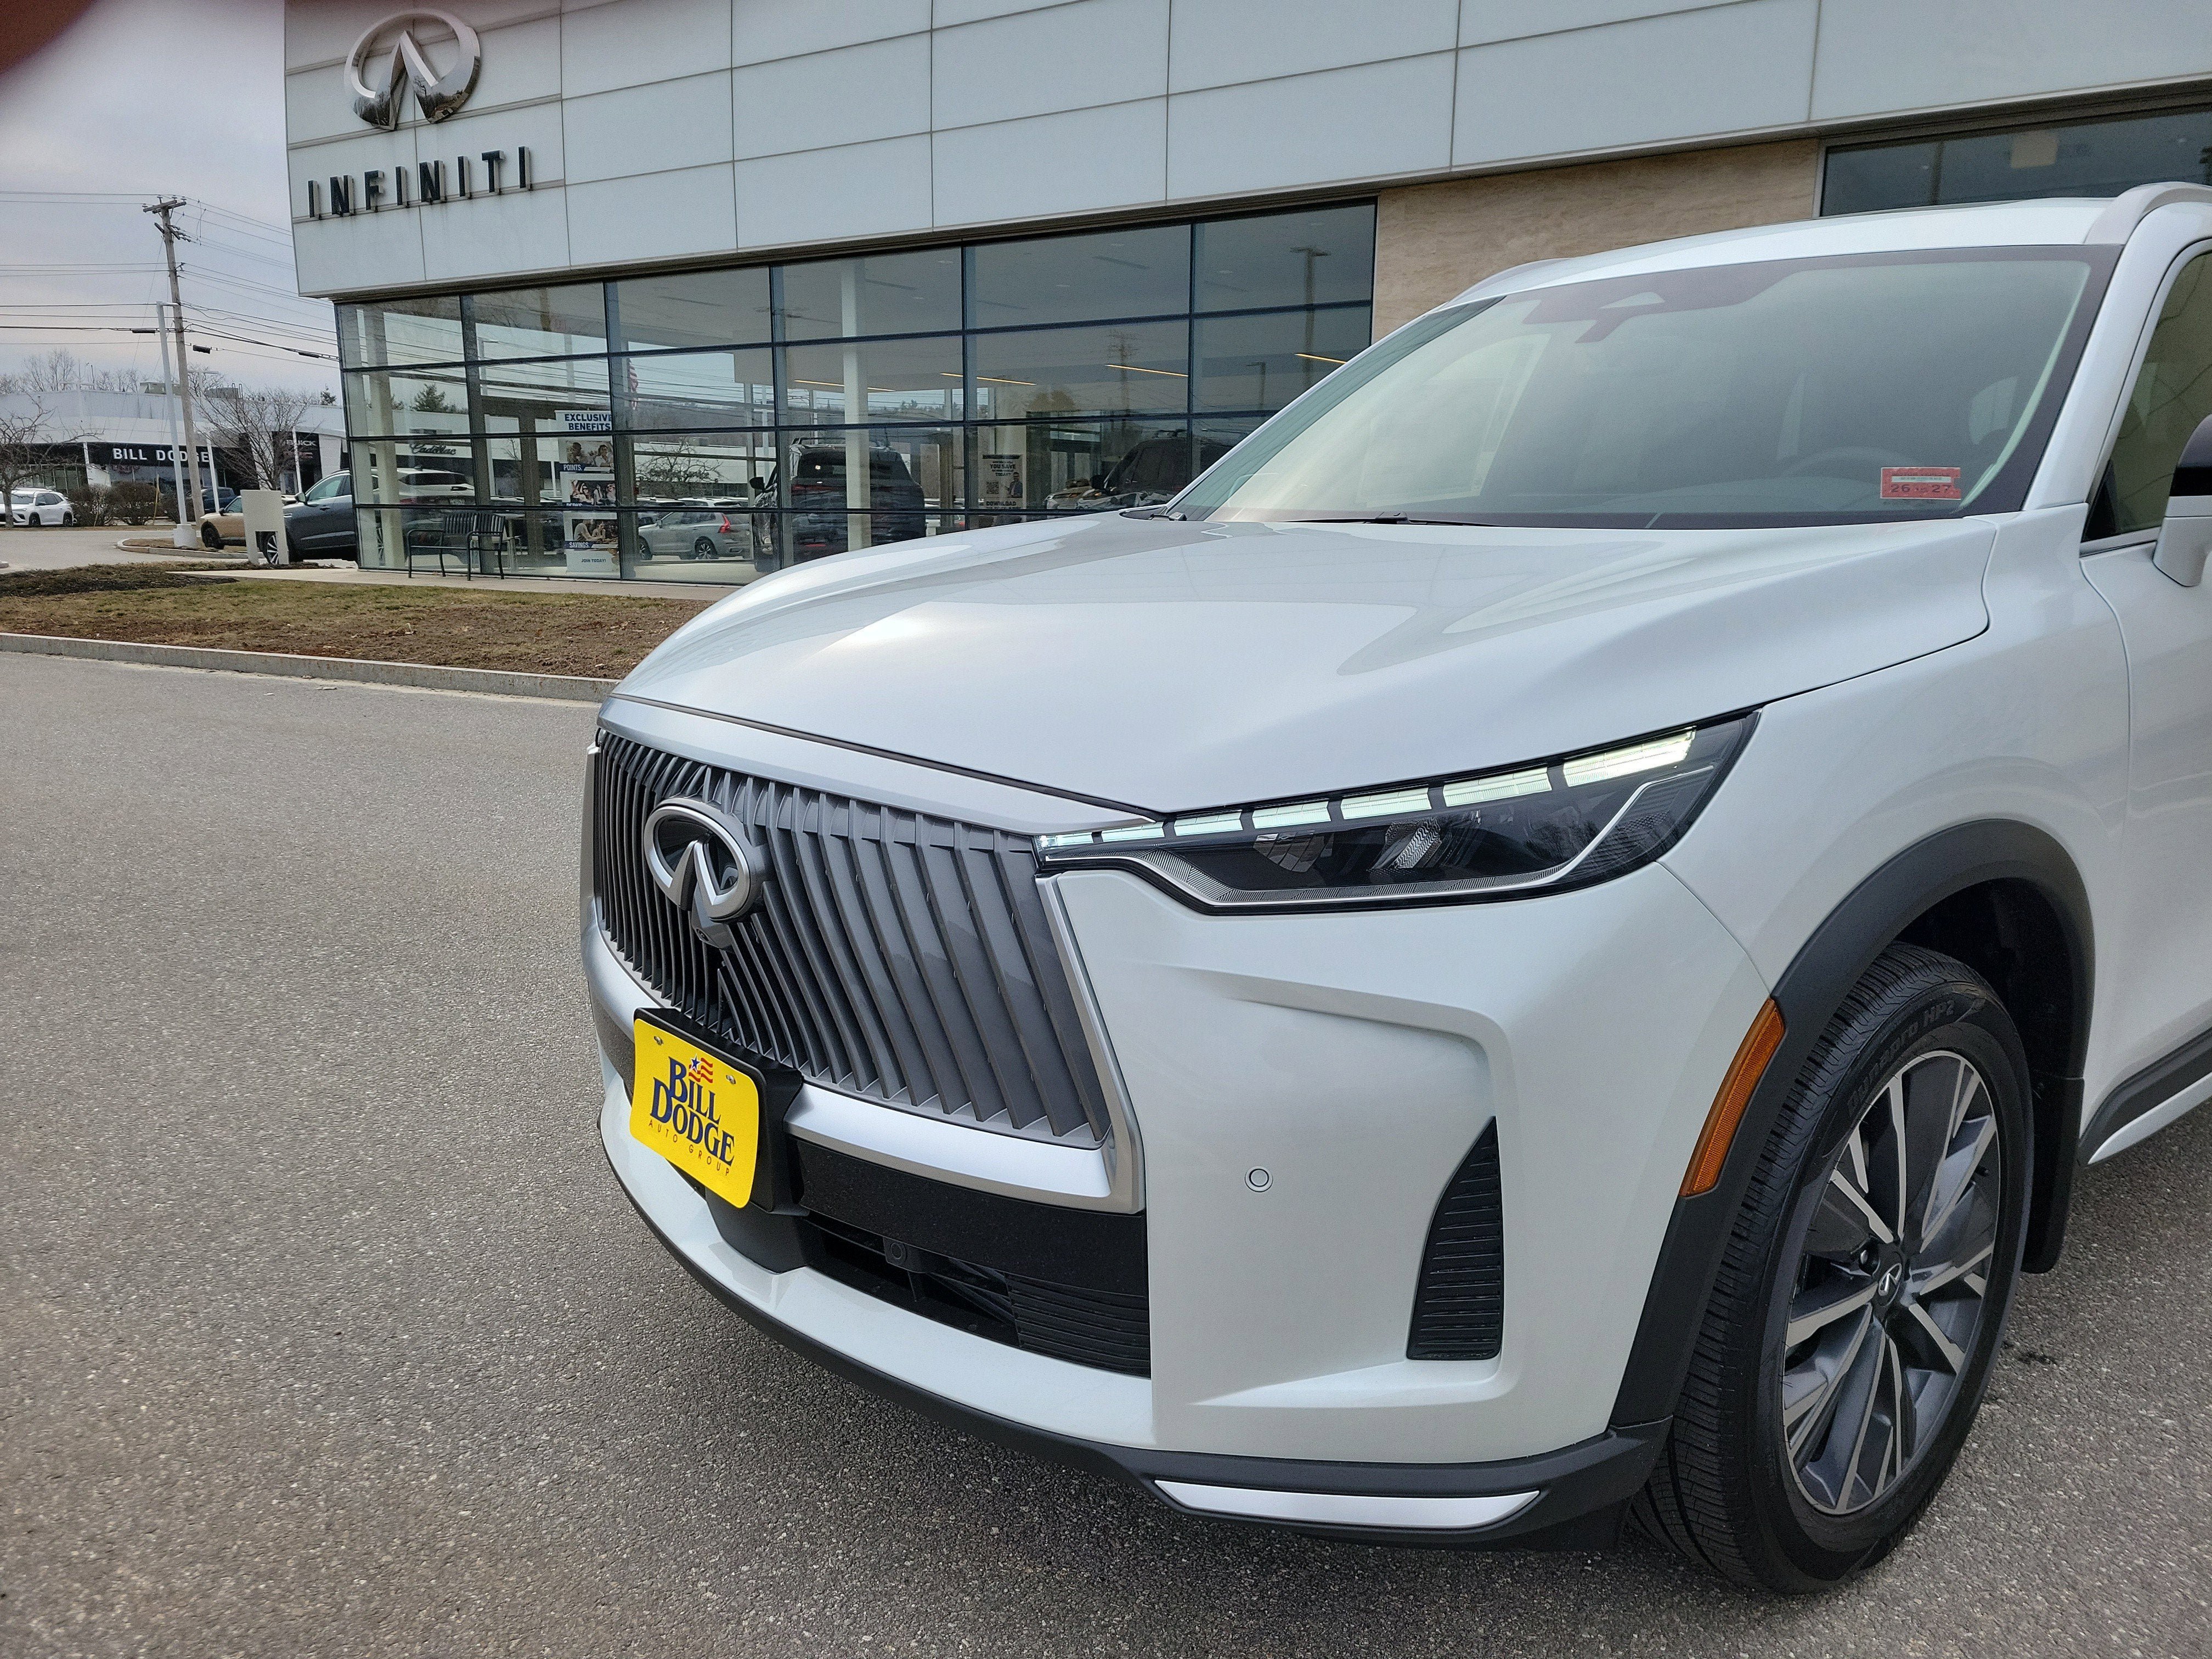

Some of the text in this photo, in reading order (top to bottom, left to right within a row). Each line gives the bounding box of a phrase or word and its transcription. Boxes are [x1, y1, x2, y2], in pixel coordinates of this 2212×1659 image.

[308, 146, 531, 219] INFINITI
[112, 448, 210, 462] BILL DODE
[568, 422, 611, 431] BENEFITS
[650, 1076, 735, 1167] DODGE
[668, 1056, 721, 1126] BILL
[648, 1119, 730, 1177] AUTO GROUP
